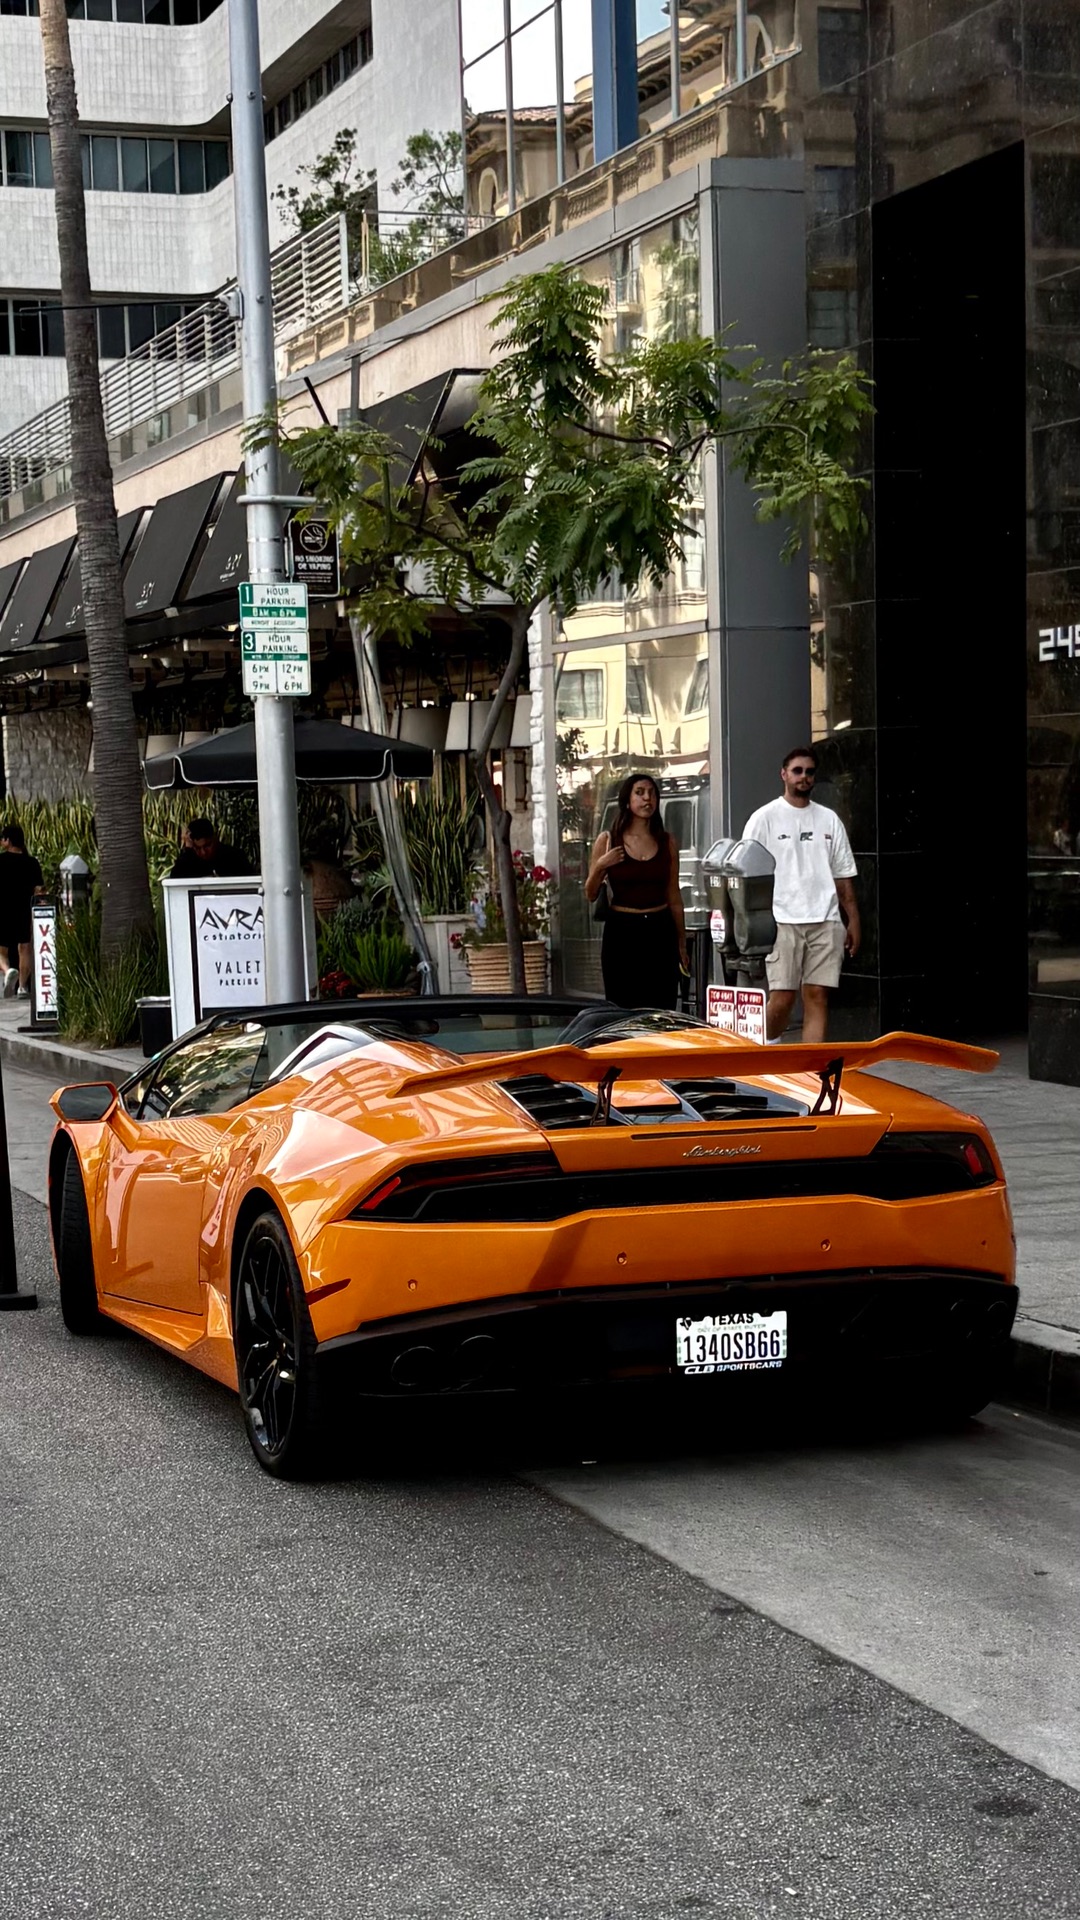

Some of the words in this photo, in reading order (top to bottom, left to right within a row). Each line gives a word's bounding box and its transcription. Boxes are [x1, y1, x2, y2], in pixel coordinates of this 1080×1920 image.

[305, 555, 335, 564] SMOKING
[245, 586, 250, 603] 1
[266, 587, 290, 596] HOUR
[244, 633, 254, 651] 3
[268, 635, 291, 643] HOUR
[262, 645, 298, 653] PARKING
[199, 906, 264, 931] AVRA
[203, 932, 263, 942] estiatori
[39, 924, 52, 1004] VALET
[215, 960, 261, 975] VALET
[219, 978, 259, 986] PARKING
[682, 1144, 762, 1158] Lamborghini
[711, 1313, 754, 1326] TEXAS
